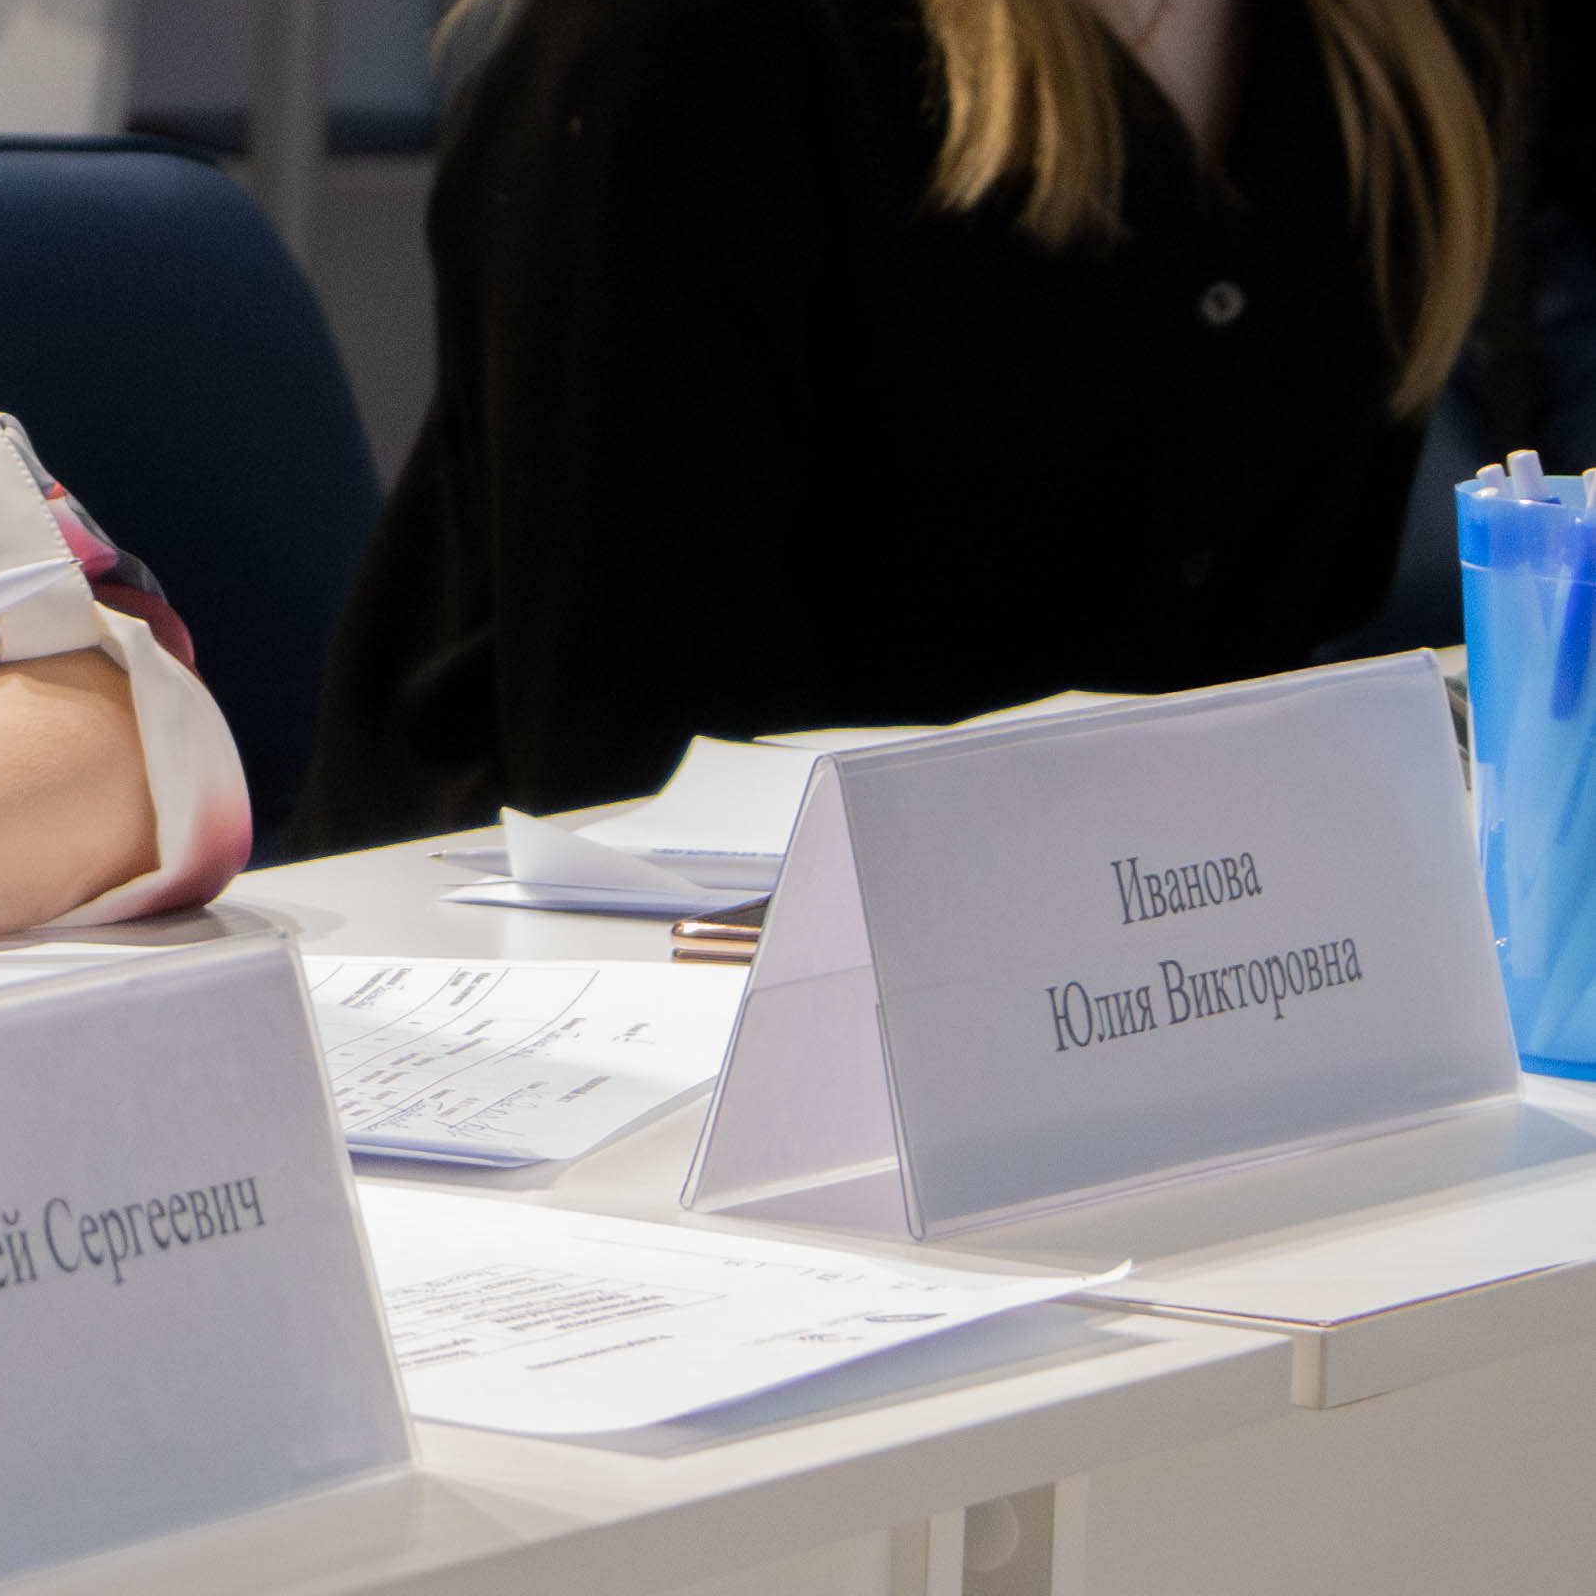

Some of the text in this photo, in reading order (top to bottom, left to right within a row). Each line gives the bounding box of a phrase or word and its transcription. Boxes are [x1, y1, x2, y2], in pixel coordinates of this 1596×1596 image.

[1111, 852, 1263, 925] Иванова
[1045, 937, 1363, 1052] Юлия Викторовна
[43, 1177, 267, 1284] Сергеевич
